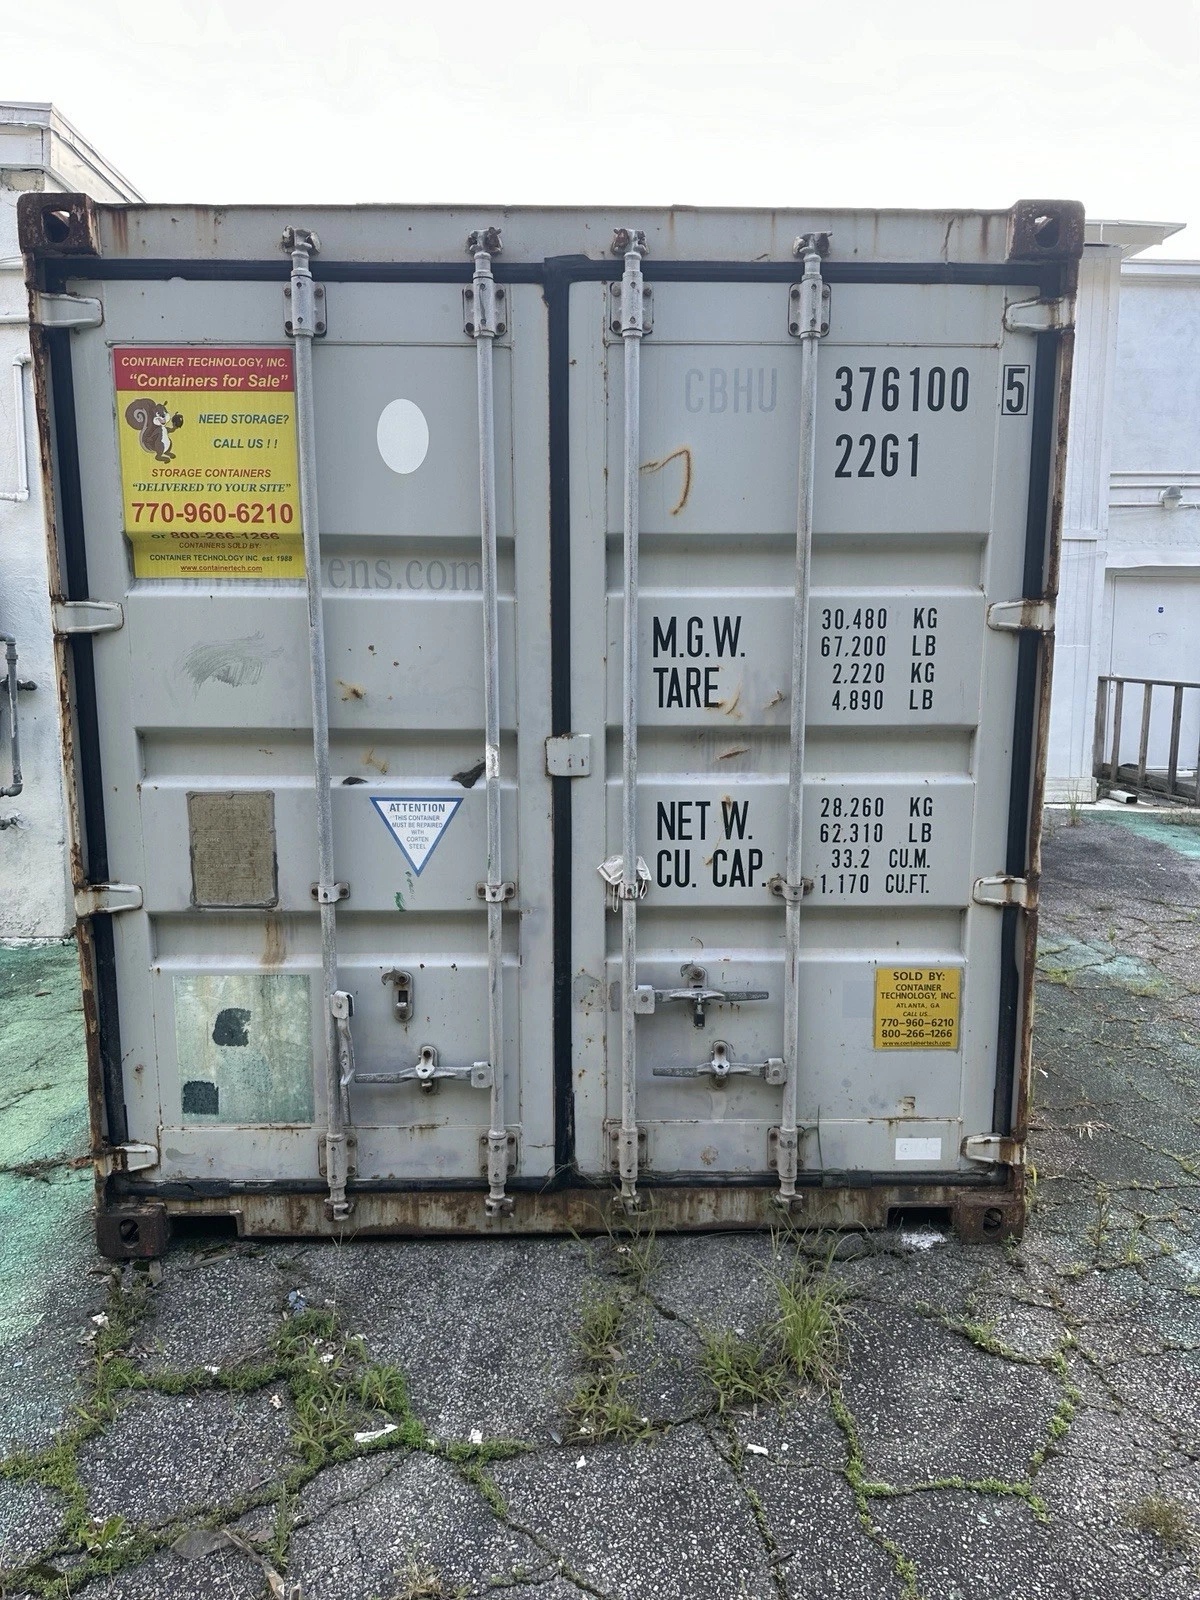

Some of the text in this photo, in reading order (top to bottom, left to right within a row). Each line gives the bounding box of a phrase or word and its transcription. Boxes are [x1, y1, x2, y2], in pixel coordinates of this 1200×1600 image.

[122, 357, 287, 368] CONTAINER TECHNOLOGY, INC.
[222, 374, 244, 387] for
[684, 366, 1026, 414] CBHU 376100 5
[199, 414, 289, 424] NEED STORAGE?
[213, 439, 244, 448] CALL
[247, 439, 264, 448] US
[834, 432, 919, 478] 22G1
[152, 468, 271, 478] STORAGE CONTAINERS
[207, 484, 222, 492] TO
[225, 484, 257, 492] YOUR
[132, 502, 293, 524] 770-960-6210
[171, 532, 280, 540] 800-266-1266
[822, 608, 938, 630] 30,480 KG
[652, 616, 746, 658] M.G.W.
[820, 635, 936, 658] 67,200 LB
[832, 662, 935, 684] 2,220 KG
[653, 667, 720, 708] TARE
[832, 690, 934, 711] 4,890 LB
[390, 803, 445, 812] ATTENTION
[820, 797, 933, 818] 28,260 KG
[656, 800, 753, 840] NET W.
[820, 822, 932, 843] 62,310 LB
[656, 848, 768, 888] CU. CAP.
[831, 848, 931, 868] 33.2 CU.M.
[820, 874, 930, 894] 1,170 CU.FT.
[893, 972, 945, 981] SOLD BY:
[882, 1030, 952, 1038] 800-266-1266
